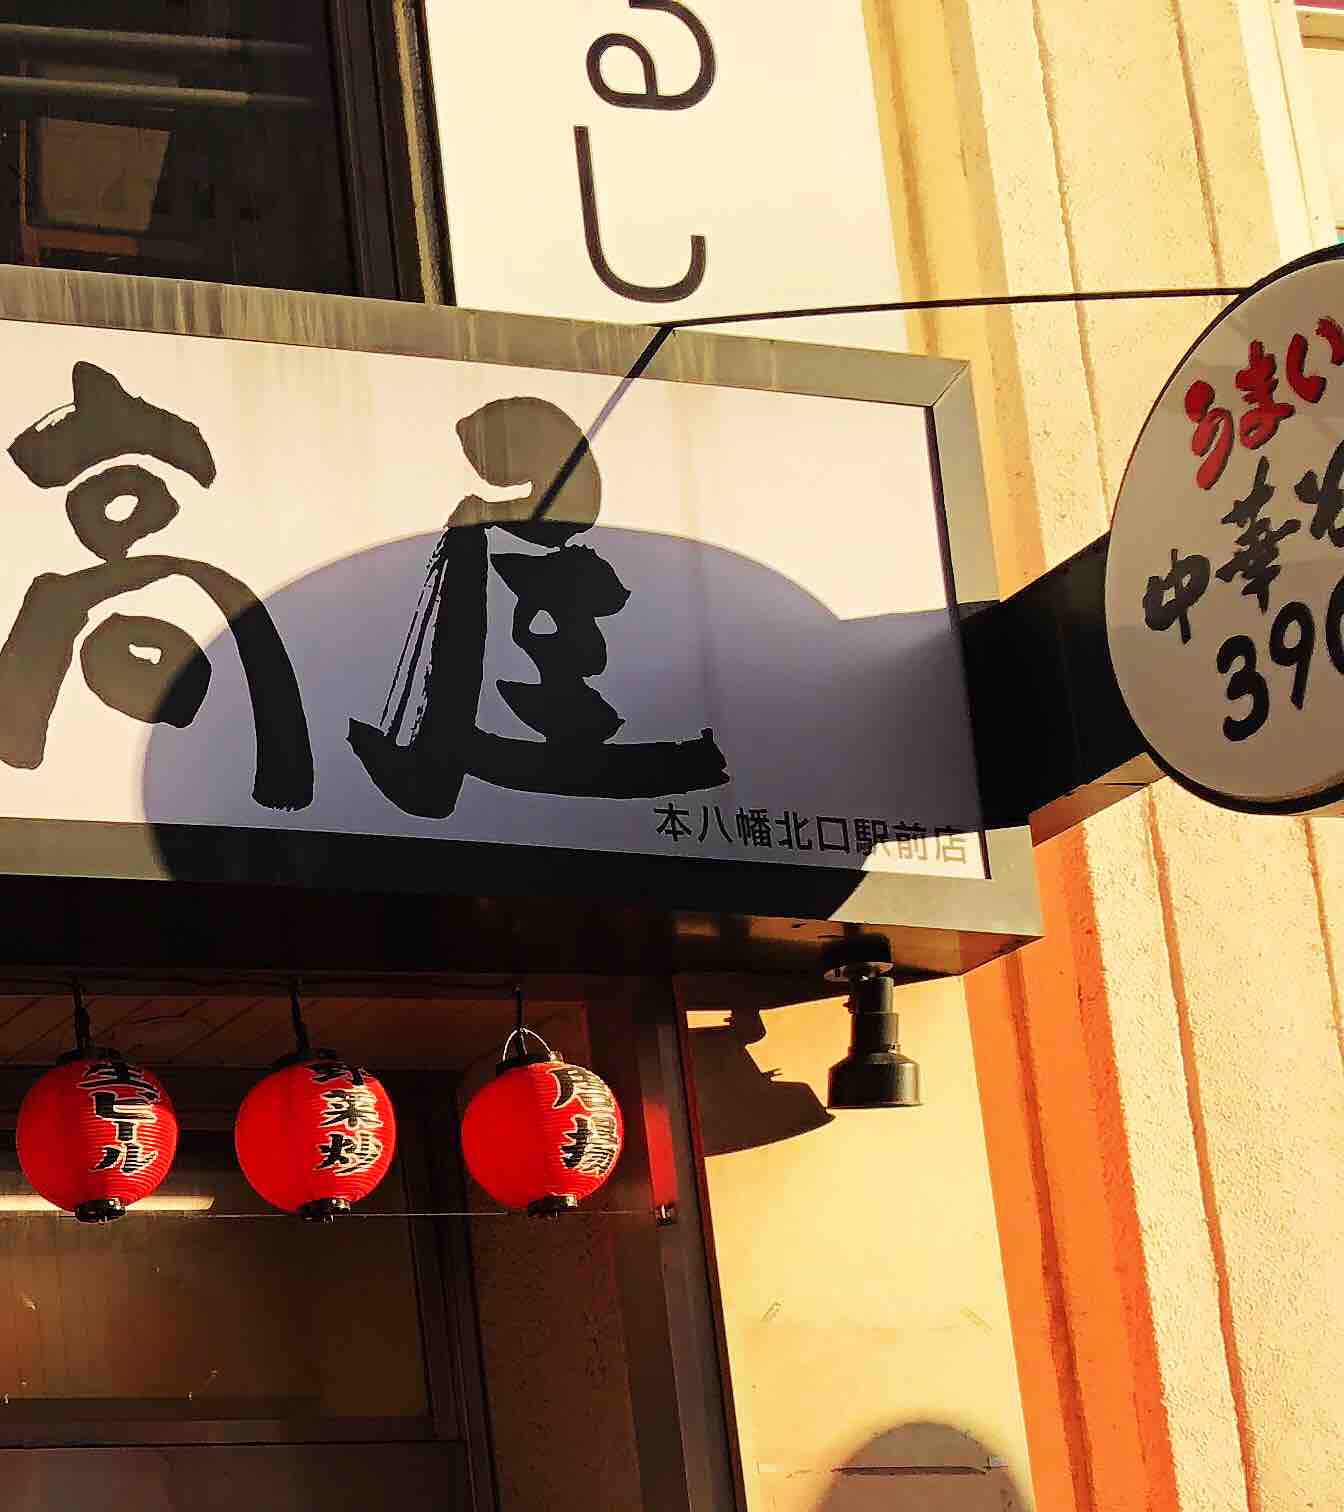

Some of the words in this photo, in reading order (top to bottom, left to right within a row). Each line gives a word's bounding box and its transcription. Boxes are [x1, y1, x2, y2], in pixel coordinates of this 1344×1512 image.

[653, 803, 968, 865] 本八幡北口駅前店
[79, 1062, 161, 1175] 生ビール
